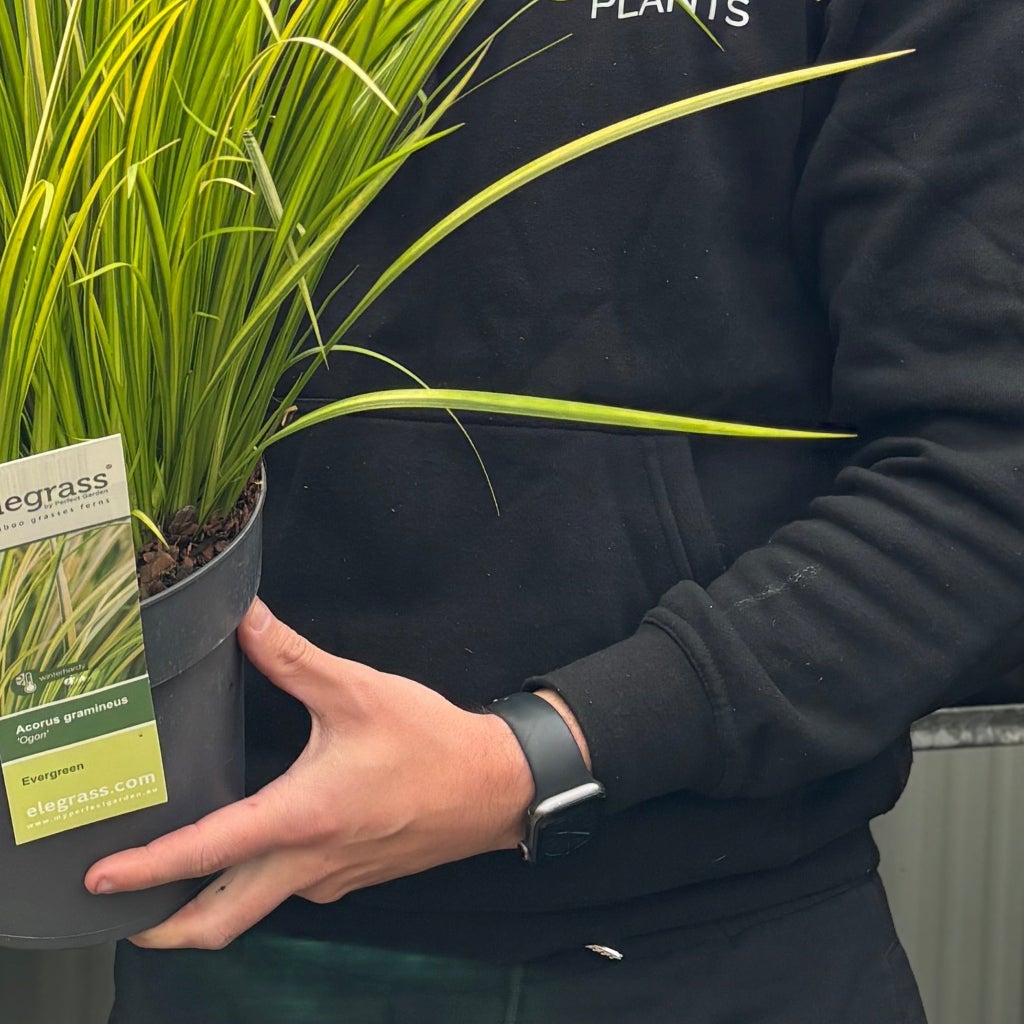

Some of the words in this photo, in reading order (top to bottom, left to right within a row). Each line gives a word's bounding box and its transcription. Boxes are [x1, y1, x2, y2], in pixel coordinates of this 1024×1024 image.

[31, 508, 74, 525] grasses
[80, 498, 110, 510] ferns
[16, 717, 61, 735] Acorus
[63, 695, 129, 724] gramineus
[22, 763, 84, 786] Evergreen
[27, 772, 156, 818] elegrass.com
